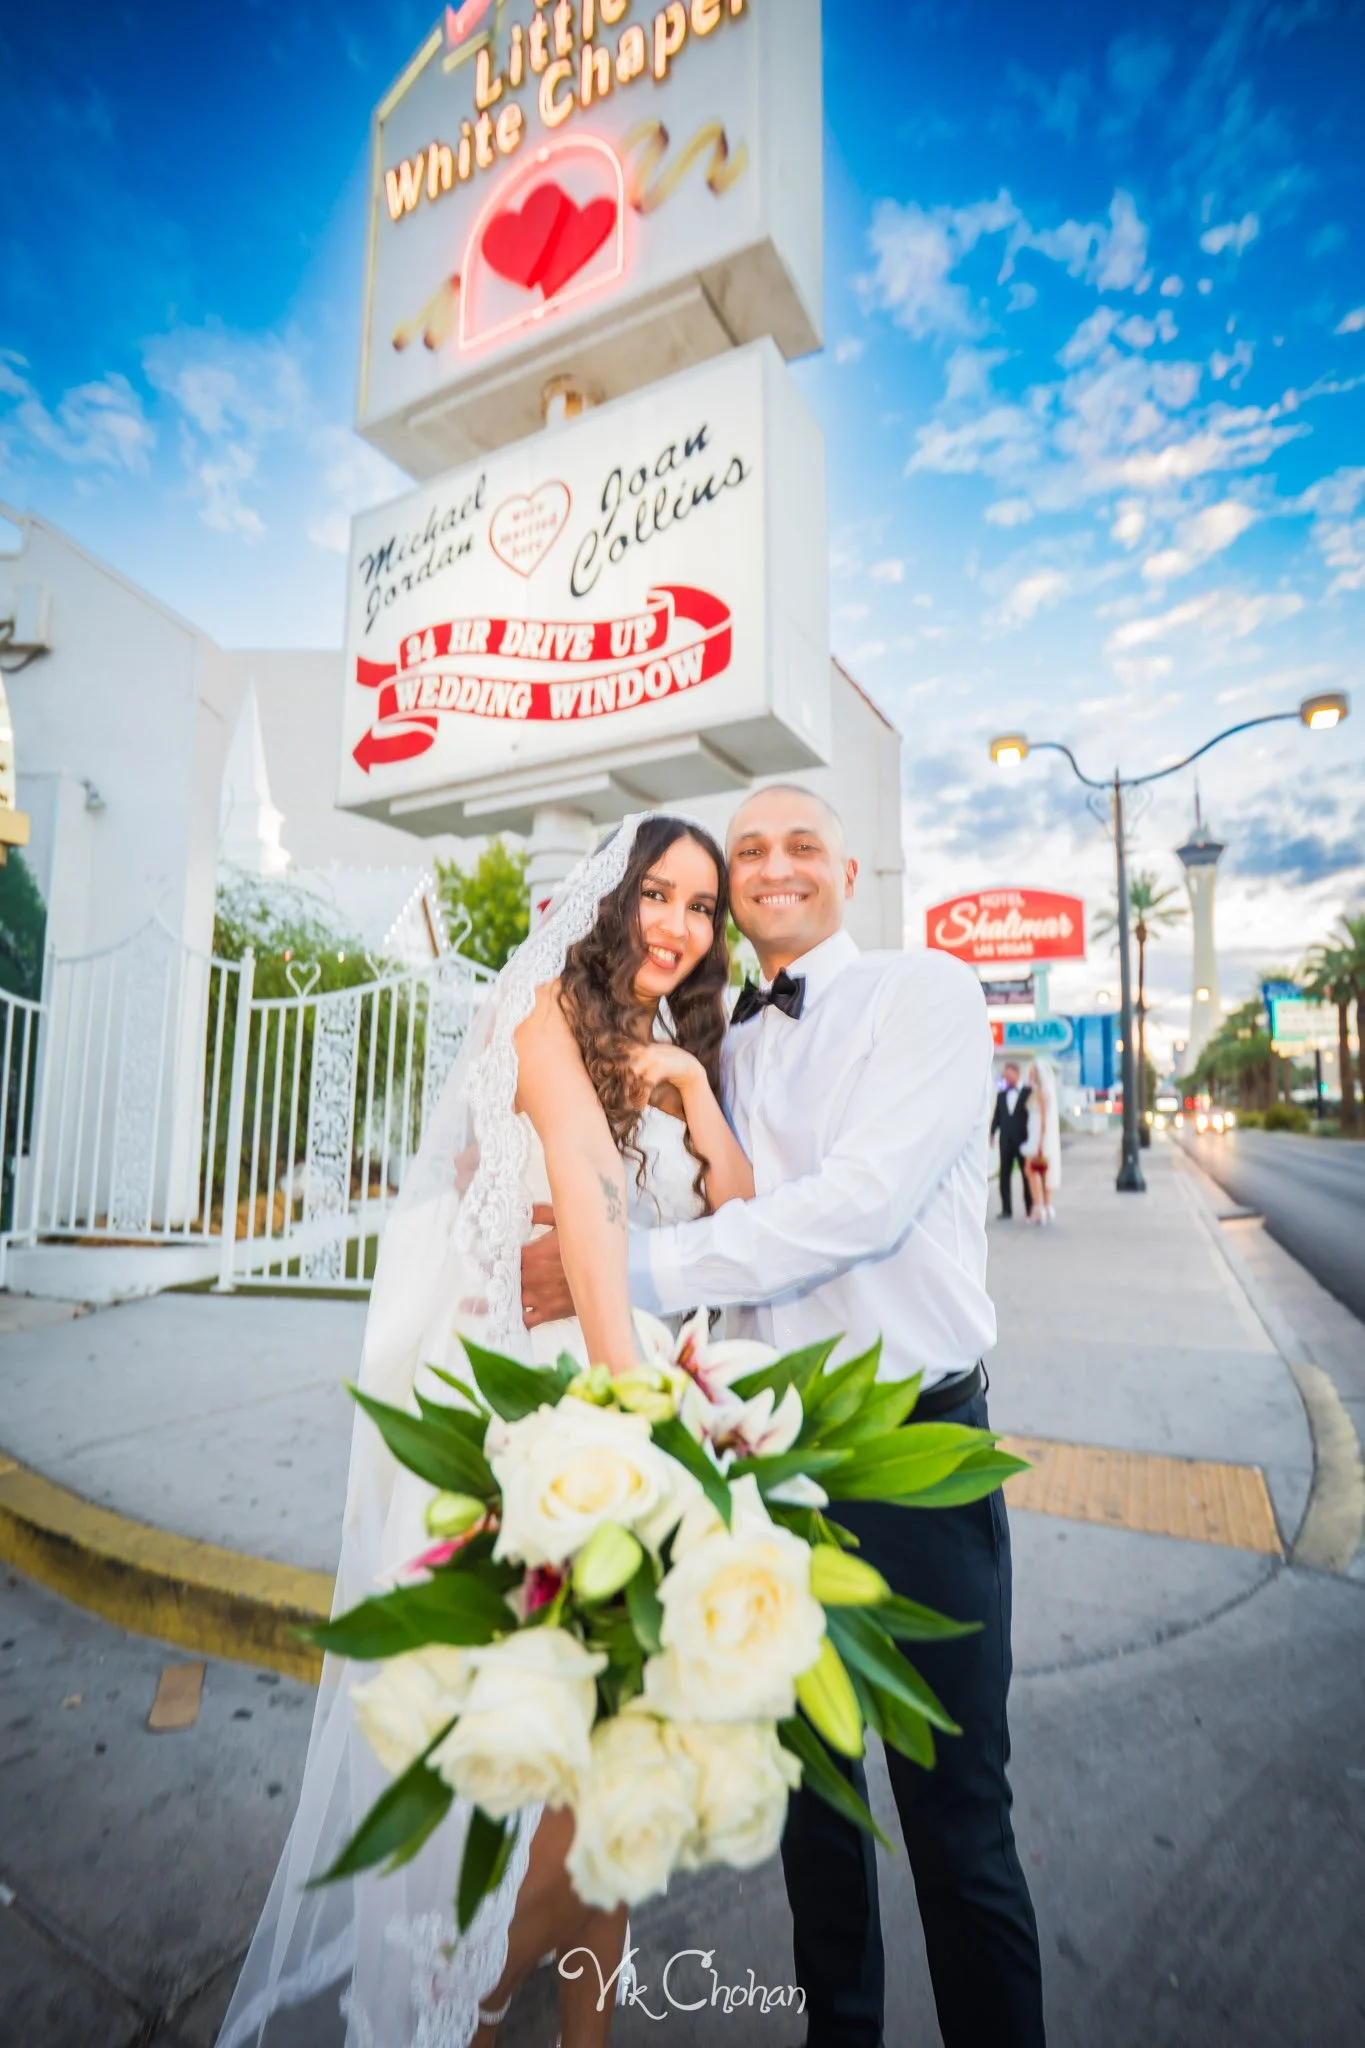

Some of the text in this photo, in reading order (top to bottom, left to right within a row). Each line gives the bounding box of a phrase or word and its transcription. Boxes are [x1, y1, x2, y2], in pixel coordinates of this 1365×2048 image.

[383, 0, 747, 222] White Chape
[601, 423, 712, 537] Joan
[359, 473, 486, 587] Michael
[569, 454, 751, 599] Collins
[365, 533, 476, 635] Jordan
[395, 643, 705, 721] WEDDING WINDOW
[406, 614, 657, 664] 24 HR DRIVE UP
[935, 901, 1074, 948] Shalimar
[979, 892, 1025, 908] HOTEL
[1006, 1021, 1062, 1040] AQUA
